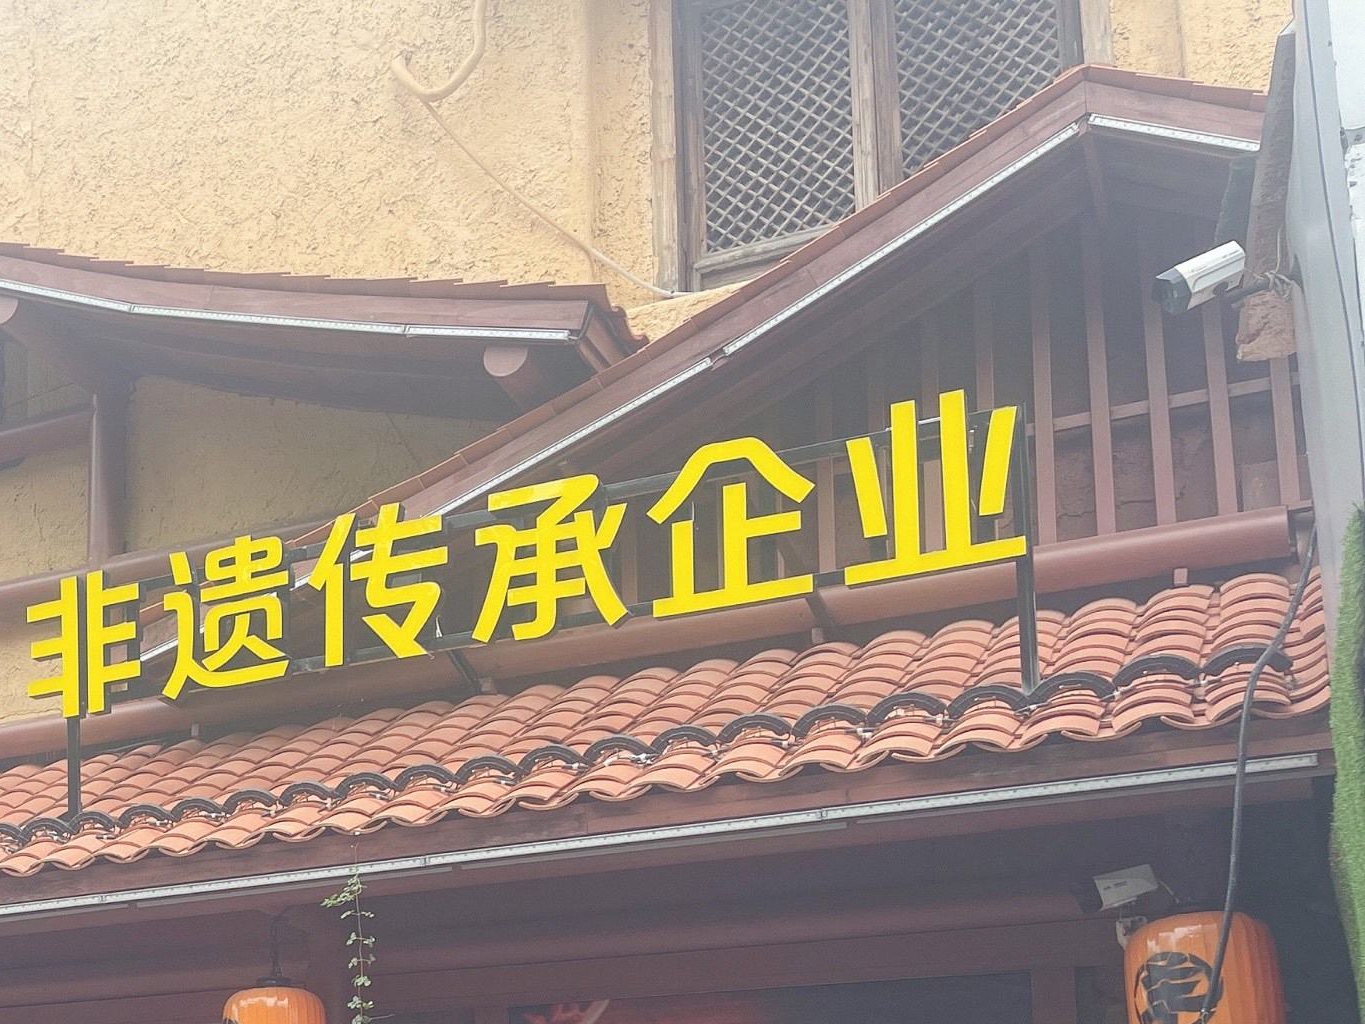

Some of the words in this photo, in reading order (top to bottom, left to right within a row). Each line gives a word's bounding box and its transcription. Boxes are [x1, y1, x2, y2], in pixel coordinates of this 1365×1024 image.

[27, 390, 1027, 718] 非遗传承企业
